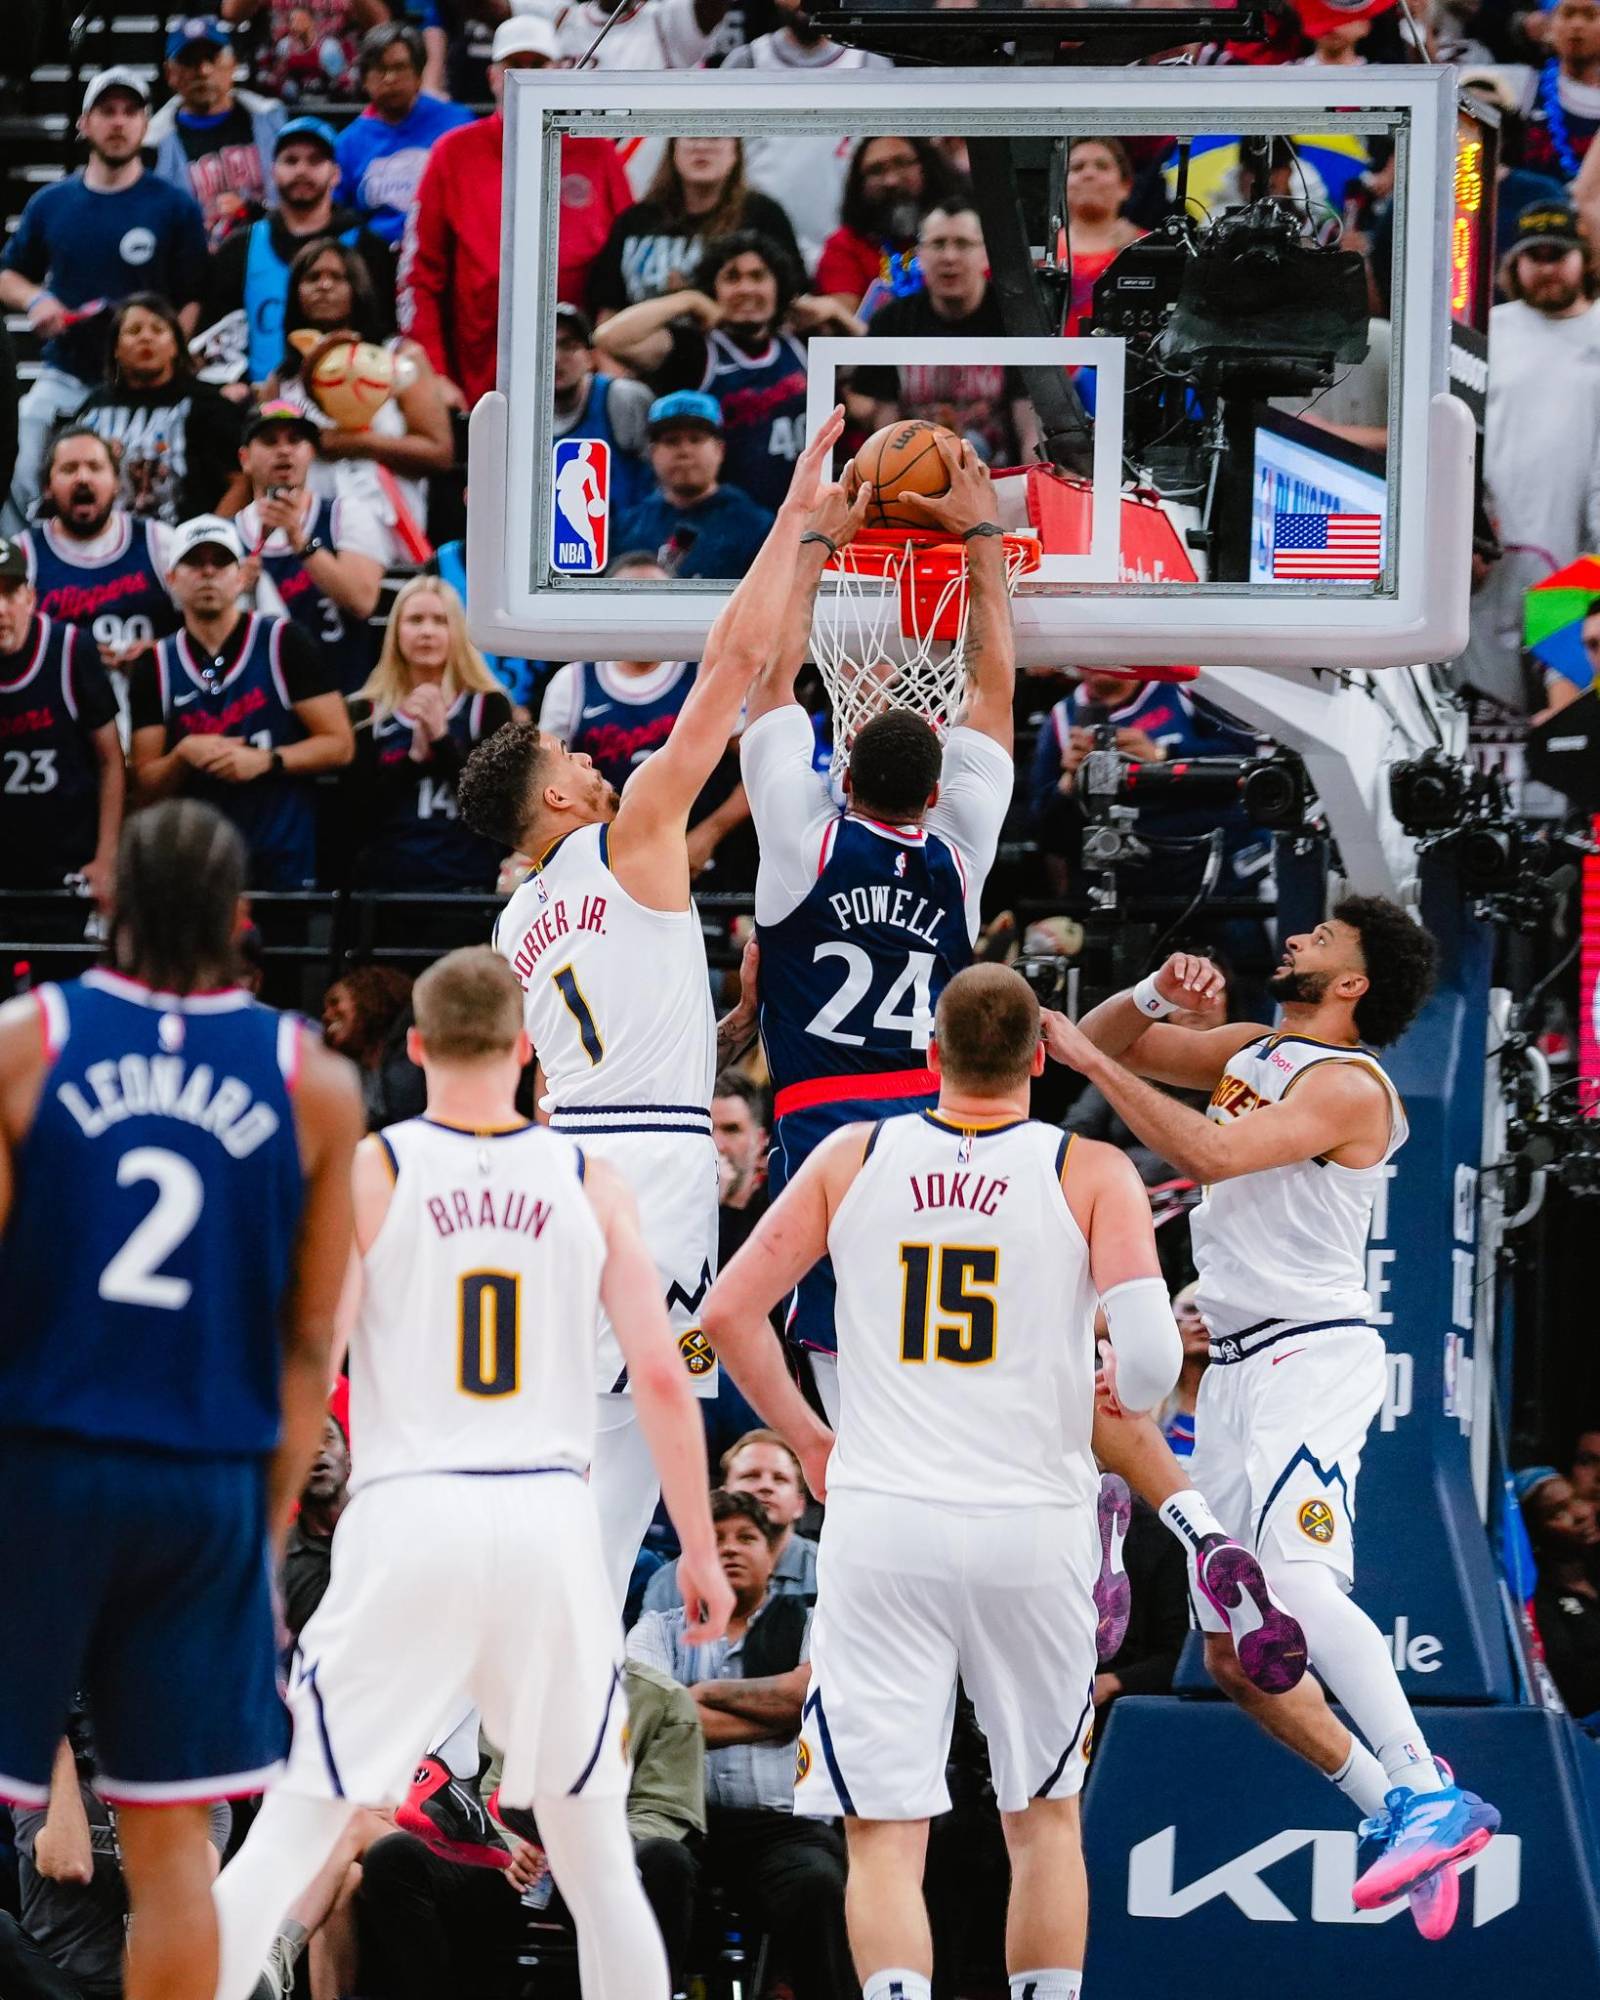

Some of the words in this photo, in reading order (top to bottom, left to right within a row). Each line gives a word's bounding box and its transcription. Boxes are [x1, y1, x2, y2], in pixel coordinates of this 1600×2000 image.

[559, 542, 586, 564] NBA
[4, 749, 59, 794] 23
[417, 777, 458, 820] 14
[577, 895, 607, 935] JR.
[828, 885, 946, 947] POWELL
[551, 962, 604, 1067] 1
[804, 941, 937, 1050] 24
[57, 1053, 280, 1159] LEONARD
[427, 1189, 552, 1240] BRAUN
[910, 1173, 1010, 1216] JOKIĆ
[98, 1146, 205, 1311] 2
[456, 1267, 522, 1401] 0
[899, 1242, 999, 1368] 15
